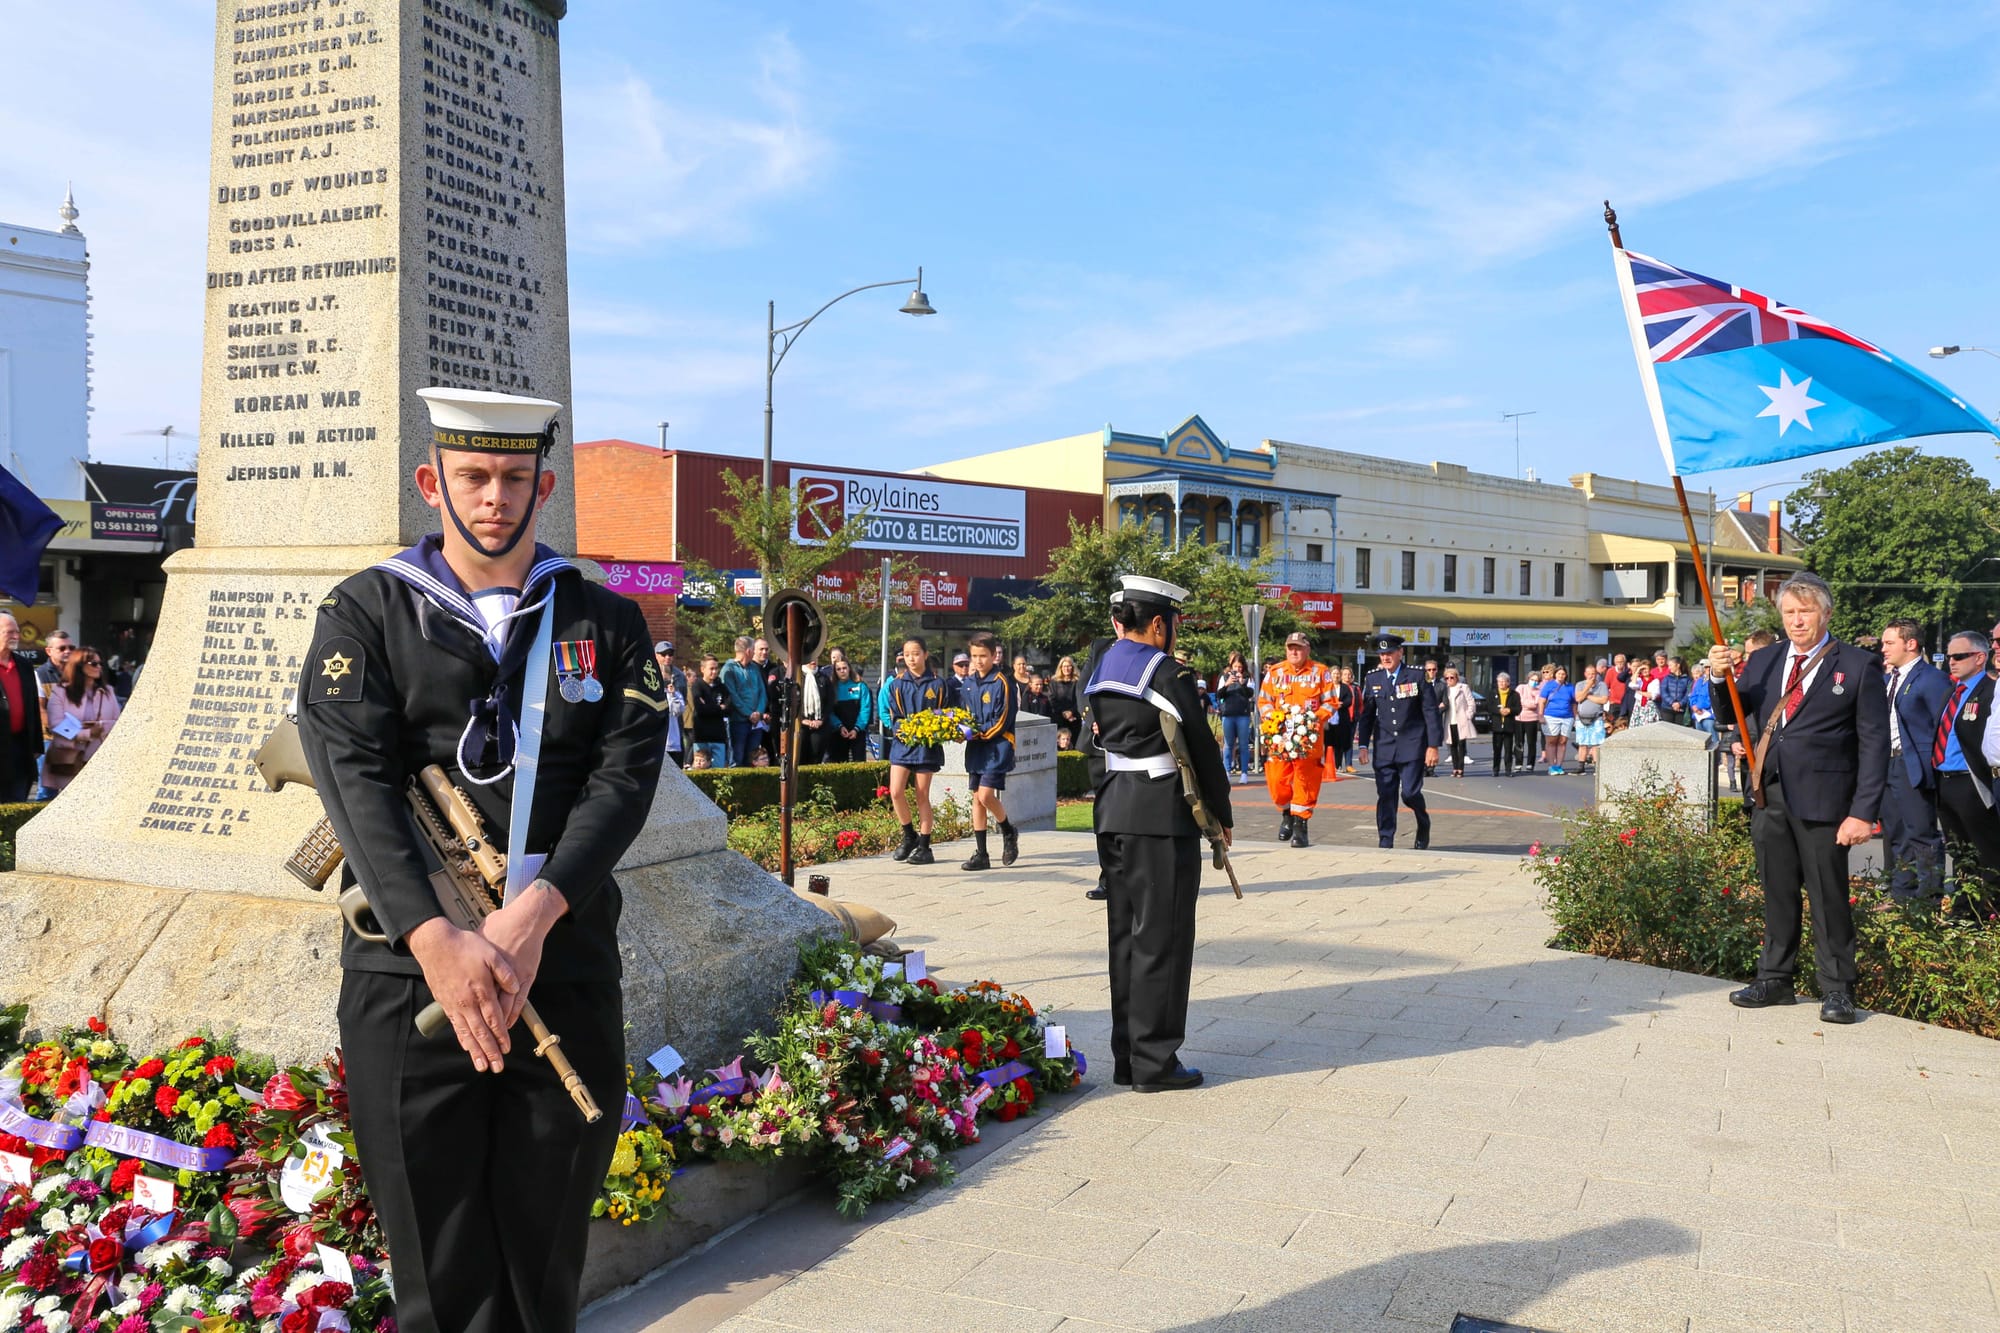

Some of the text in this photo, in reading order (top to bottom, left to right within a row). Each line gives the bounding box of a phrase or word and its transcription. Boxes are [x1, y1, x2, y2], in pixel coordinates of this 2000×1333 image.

[234, 0, 320, 23] ASHCROFT
[503, 2, 557, 41] ACTION
[233, 20, 308, 44] BENNETT
[423, 15, 495, 60] MEREDITH
[233, 36, 342, 65] FAIRWEATHER
[424, 36, 468, 69] MILLS
[233, 62, 311, 85] GARDNER
[424, 58, 469, 88] MILLS
[232, 85, 294, 107] HARDIE
[424, 80, 496, 121] MITCHELL
[232, 103, 321, 127] MARSHALL
[231, 119, 357, 148] POLKINGHORNE
[232, 149, 295, 169] WRIGHT
[218, 167, 388, 204] DIED OF WOUNDS
[426, 187, 481, 217] PALMER
[229, 211, 317, 233] GOODWILL
[427, 208, 474, 235] PAYNE
[229, 236, 275, 254] ROSS
[427, 229, 508, 266] PEDERSON
[206, 256, 397, 289] DIED AFTER RETURNING
[428, 250, 512, 287] PLEASANCE
[228, 300, 300, 318] KEATING
[428, 294, 496, 322] RAEBURN
[228, 322, 283, 338] MURIE
[428, 315, 476, 338] REIDY
[227, 342, 298, 360] SHIELDS
[429, 335, 485, 361] RINTEL
[226, 363, 280, 381] SMITH
[429, 356, 490, 381] ROGERS
[234, 390, 361, 413] KOREAN WAR
[220, 427, 377, 448] KILLED IN ACTION
[471, 436, 538, 449] CERBERUS
[226, 465, 301, 482] JEPHSON
[848, 480, 939, 511] Roylaines
[105, 510, 128, 519] OPEN
[136, 512, 156, 520] DAYS
[94, 521, 106, 530] 03
[134, 523, 158, 533] 2199
[907, 524, 918, 540] &
[921, 523, 1017, 547] ELECTRONICS
[608, 564, 673, 592] & Spa
[817, 574, 842, 587] Photo
[938, 580, 957, 594] Copy
[210, 590, 274, 603] HAMPSON
[938, 594, 963, 606] Centre
[208, 605, 266, 618] HAYMAN
[205, 620, 245, 634] HEILY
[203, 636, 236, 649] HILL
[200, 652, 257, 665] LARKAN
[193, 682, 273, 699] MARSHALL
[190, 698, 257, 713] NICOLSON
[180, 729, 254, 744] PETERSON
[162, 773, 238, 790] QUARRELL
[155, 787, 183, 801] RAE
[147, 802, 214, 818] ROBERTS
[139, 816, 196, 832] SAVAGE
[127, 1134, 151, 1154] WE
